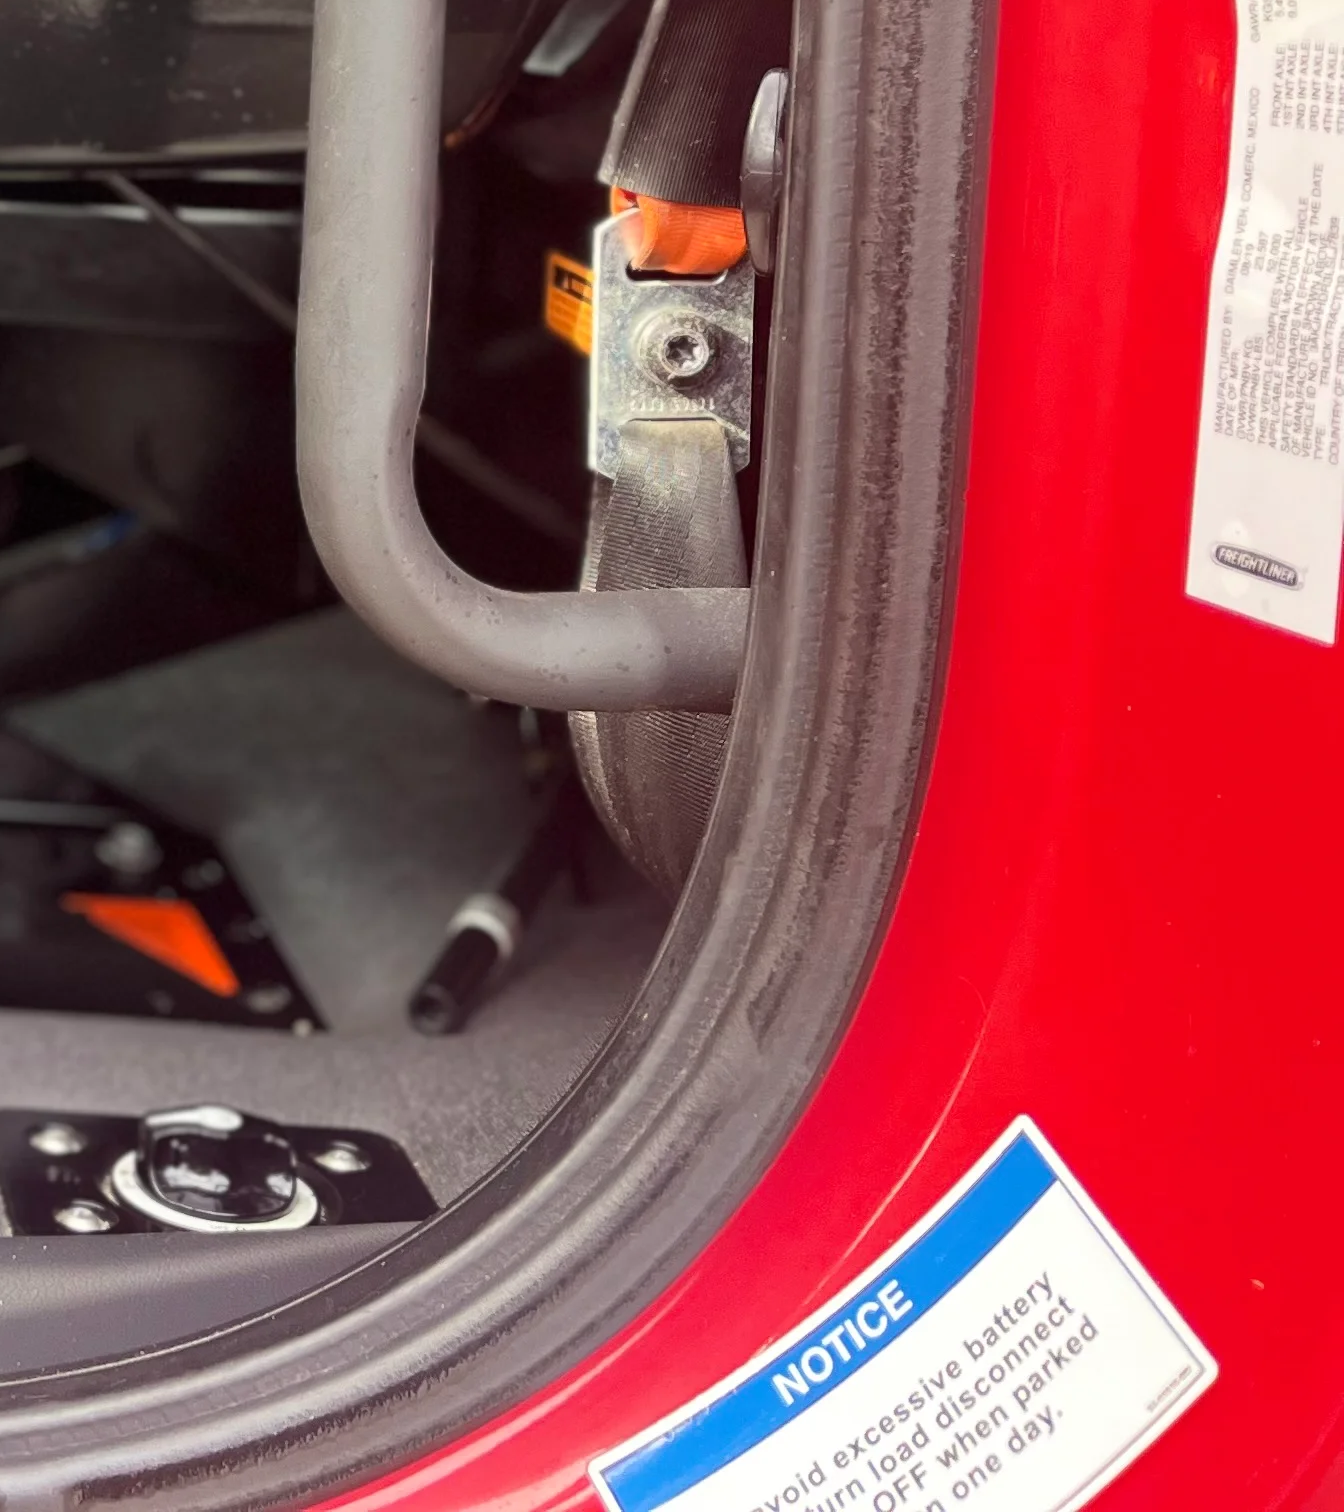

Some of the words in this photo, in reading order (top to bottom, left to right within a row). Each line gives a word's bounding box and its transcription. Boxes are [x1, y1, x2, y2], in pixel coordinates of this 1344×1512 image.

[1269, 82, 1284, 127] FRONT
[1284, 80, 1295, 100] INT
[1297, 78, 1308, 99] INT
[1312, 79, 1322, 101] INT
[1325, 83, 1336, 104] INT
[1283, 103, 1293, 126] 1ST
[1296, 103, 1307, 130] 2ND
[1323, 108, 1334, 133] 4TH
[1312, 162, 1324, 198] DATE
[1294, 196, 1309, 251] VEHICLE
[1310, 201, 1321, 226] THE
[1282, 226, 1295, 249] ALL
[1308, 230, 1319, 247] AT
[1313, 232, 1329, 278] ABOVE
[1214, 329, 1232, 433] MANUFACTURED
[1224, 238, 1242, 294] DAIMLER
[1247, 88, 1260, 138] MEXICO
[1274, 251, 1290, 284] WITH
[1281, 256, 1301, 304] MOTOR
[1297, 248, 1316, 298] EFFECT
[1265, 288, 1282, 355] COMPLIES
[1293, 302, 1304, 315] IN
[1302, 281, 1322, 330] SHOWN
[1275, 308, 1290, 367] FEDERAL
[1285, 319, 1301, 399] STANDARDS
[1228, 383, 1236, 400] OF
[1261, 359, 1274, 412] VEHICLE
[1293, 334, 1311, 433] MANUFACTURE
[1306, 386, 1317, 398] ID
[1225, 404, 1236, 436] DATE
[1258, 417, 1268, 445] THIS
[1268, 371, 1284, 449] APPLICABLE
[1280, 401, 1293, 453] SAFETY
[1302, 402, 1315, 458] VEHICLE
[1328, 399, 1342, 465] COUNTRY
[1291, 438, 1301, 456] OF
[1219, 548, 1295, 584] FREIGHTLINER
[771, 1279, 914, 1408] NOTICE
[750, 1460, 826, 1512] void
[833, 1360, 963, 1470] excessive
[963, 1271, 1054, 1362] battery
[867, 1422, 931, 1481] load
[935, 1295, 1076, 1430] disconnect
[873, 1461, 928, 1512] OFF
[936, 1405, 1010, 1470] when
[1012, 1314, 1100, 1412] parked
[952, 1454, 1003, 1502] one
[1007, 1405, 1064, 1455] day.
